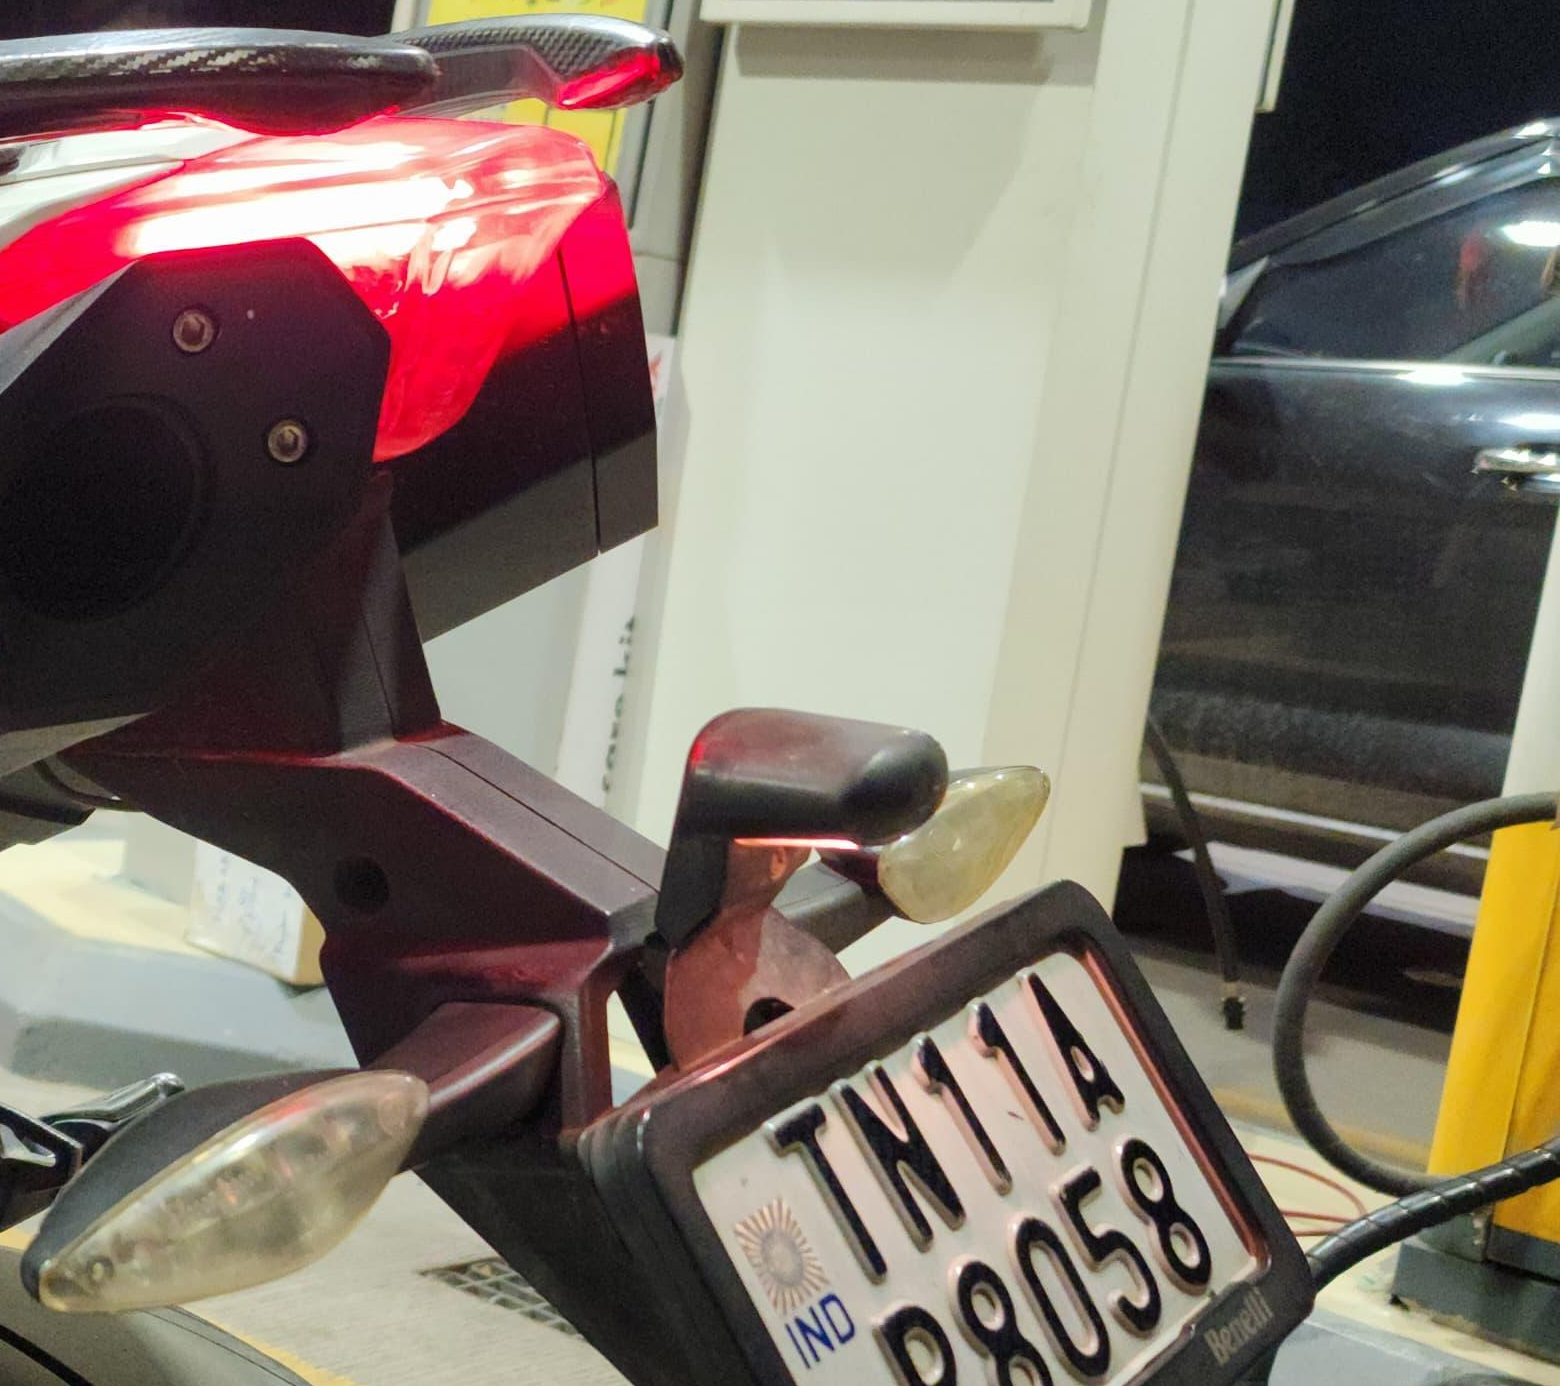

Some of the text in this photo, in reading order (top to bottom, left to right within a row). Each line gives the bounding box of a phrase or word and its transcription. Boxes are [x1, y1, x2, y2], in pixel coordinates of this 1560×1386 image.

[766, 970, 1126, 1283] TN11A
[785, 1293, 856, 1370] IND
[1203, 1287, 1274, 1366] Benelli
